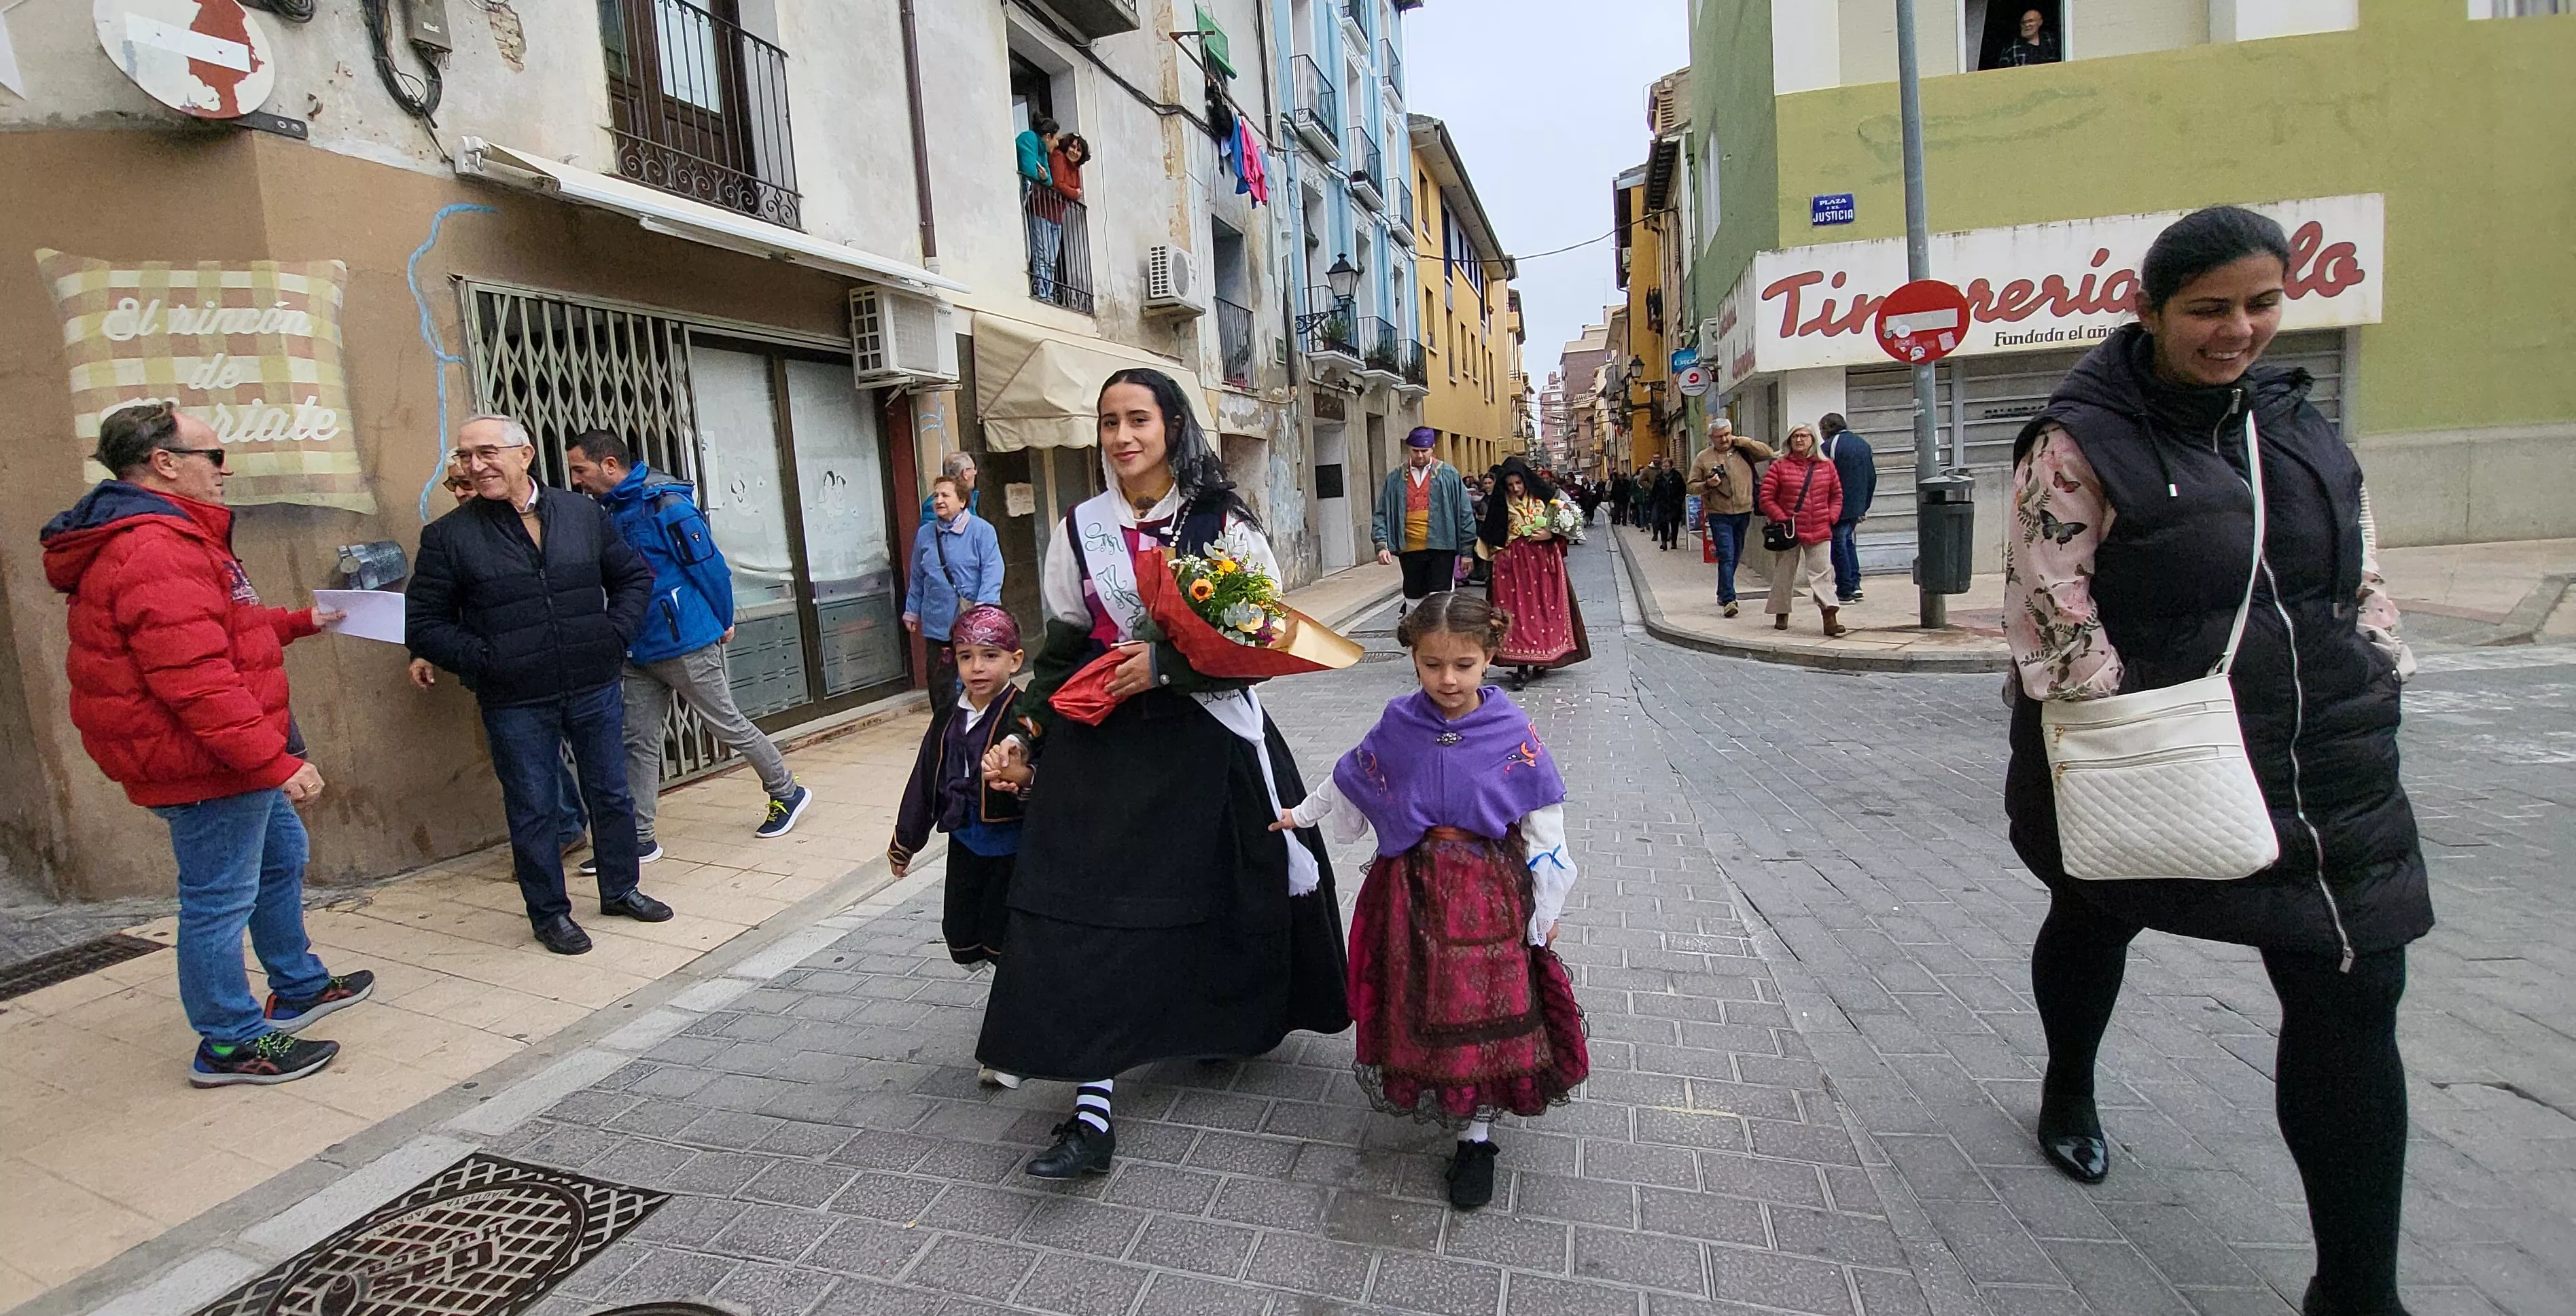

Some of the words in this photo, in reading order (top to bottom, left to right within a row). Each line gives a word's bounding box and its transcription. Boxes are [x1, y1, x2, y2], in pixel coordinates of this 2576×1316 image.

[1813, 209, 1854, 223] JUSTICIA
[1761, 247, 2140, 338] Tinrería
[103, 298, 160, 340] El
[167, 301, 313, 338] rincón
[1994, 327, 2065, 347] Fundada
[2068, 325, 2084, 340] el
[188, 353, 243, 389] de
[446, 1190, 508, 1207] BAUTISTA
[368, 1224, 504, 1275] Huesca
[372, 1241, 493, 1297] Gas
